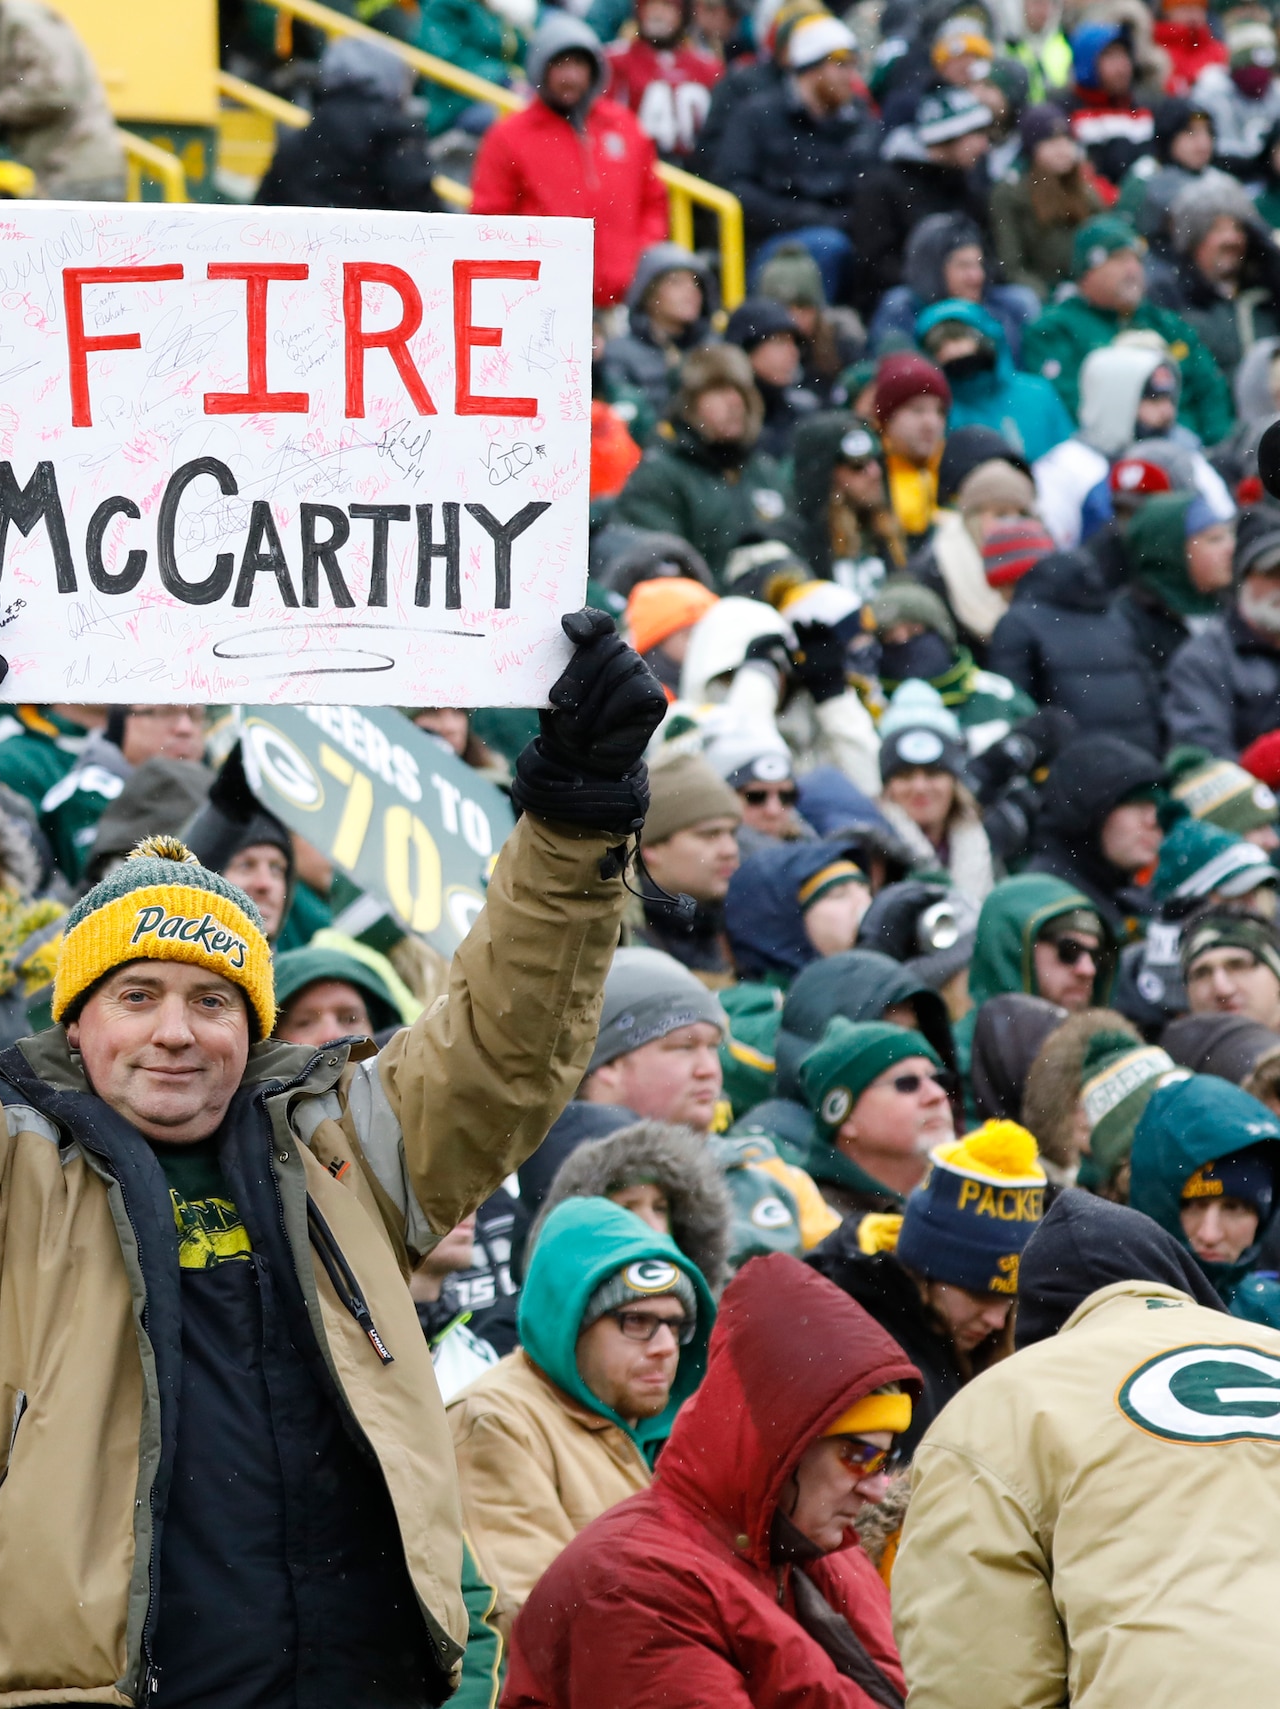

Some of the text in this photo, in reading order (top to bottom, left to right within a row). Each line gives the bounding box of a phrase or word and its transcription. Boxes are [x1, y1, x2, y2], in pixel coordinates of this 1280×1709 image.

[62, 259, 541, 427] FIRE
[294, 706, 493, 858] EERS TO
[319, 742, 443, 933] 70
[130, 905, 248, 968] Packers
[957, 1179, 1044, 1222] PACKE
